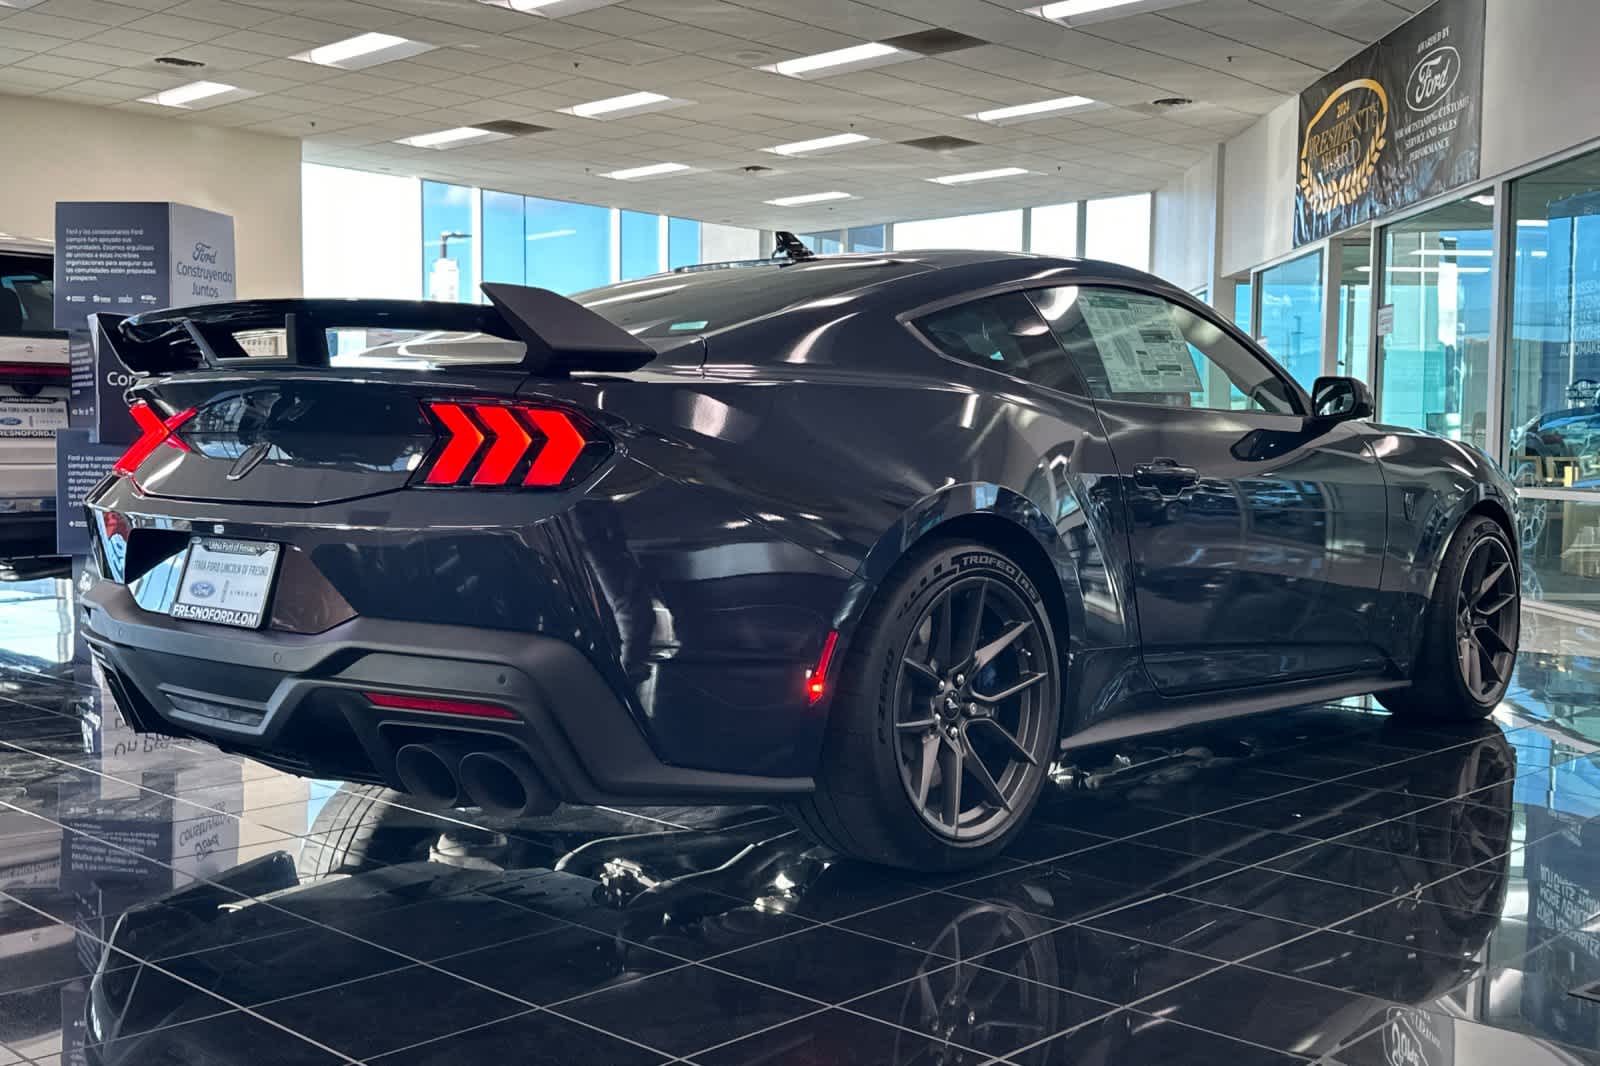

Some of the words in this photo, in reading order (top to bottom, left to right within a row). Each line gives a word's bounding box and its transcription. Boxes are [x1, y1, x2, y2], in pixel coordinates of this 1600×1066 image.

[1415, 55, 1451, 104] Ford
[1426, 126, 1437, 140] AND
[1438, 118, 1457, 133] SALES
[192, 242, 216, 264] Ford
[176, 261, 232, 283] Construyendo
[192, 282, 219, 298] Juntos
[223, 543, 233, 552] Ford
[207, 561, 220, 572] FORD
[962, 555, 1016, 575] TROFEO
[173, 603, 257, 626] FRESNOFORD.COM
